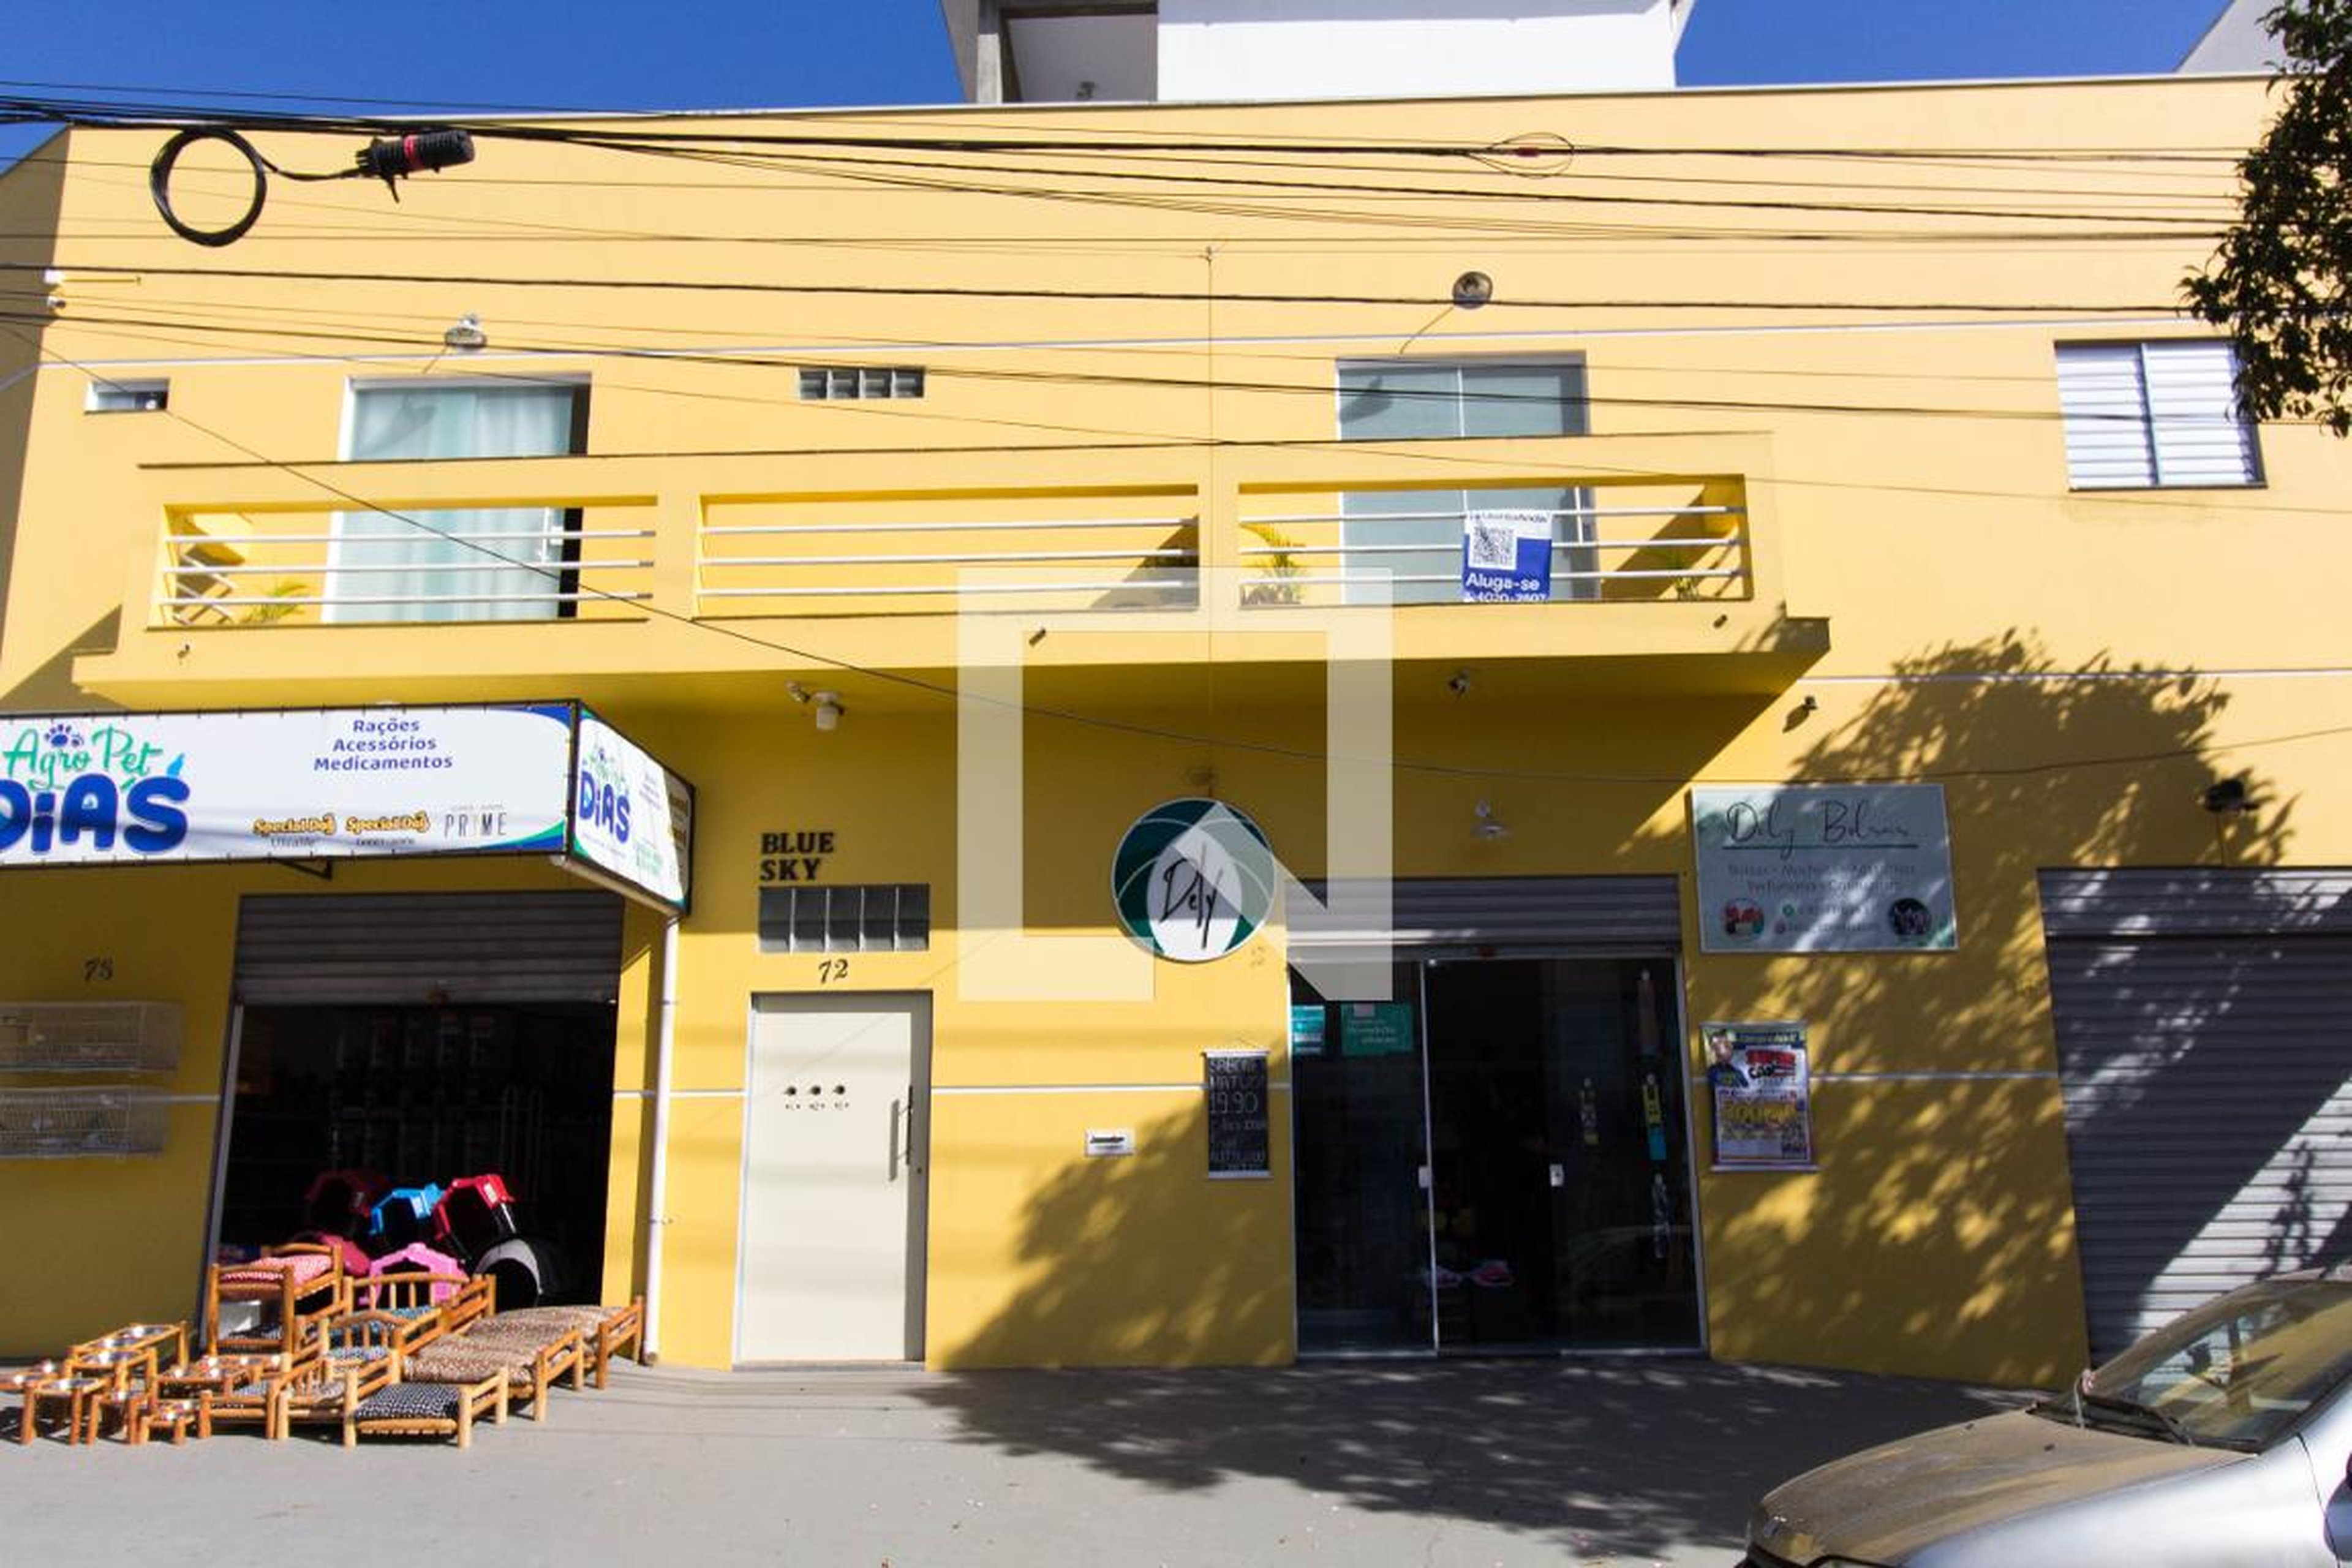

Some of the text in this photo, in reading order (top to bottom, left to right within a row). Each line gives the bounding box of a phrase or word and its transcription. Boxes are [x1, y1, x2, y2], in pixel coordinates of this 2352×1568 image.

[1466, 573, 1540, 592] Aluga-se
[353, 718, 420, 736] Rações
[333, 736, 437, 752] Acessórios
[2, 725, 164, 791] Agro Pet
[314, 755, 453, 771] Medicamentos
[761, 832, 834, 854] BLUE
[760, 858, 821, 881] SKY
[1159, 842, 1224, 950] Dely
[818, 959, 849, 983] 72
